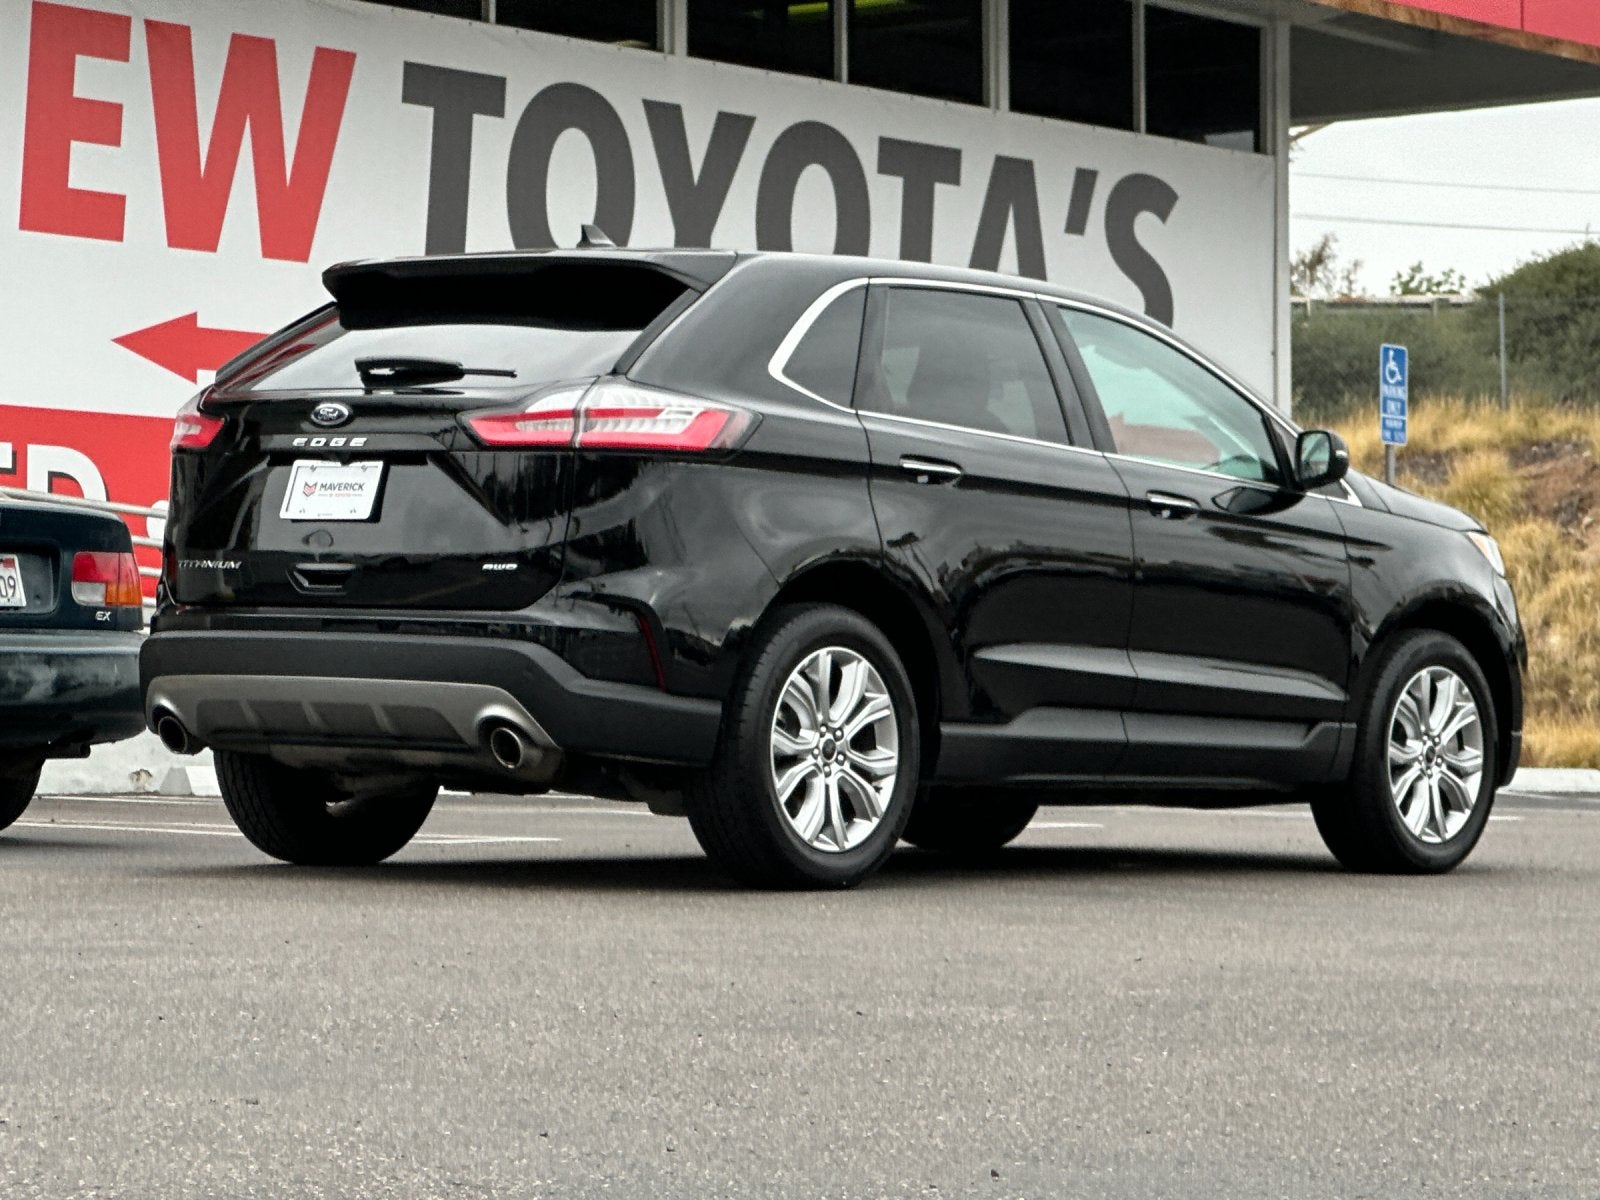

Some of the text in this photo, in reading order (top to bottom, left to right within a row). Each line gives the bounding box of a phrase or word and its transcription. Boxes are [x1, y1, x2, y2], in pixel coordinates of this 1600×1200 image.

[19, 0, 1179, 328] EW TOYOTA'S
[292, 437, 367, 447] EDGE
[319, 482, 365, 491] MAVERICK
[178, 559, 242, 569] TITANIUM
[482, 563, 518, 571] AWD
[95, 610, 111, 622] EX
